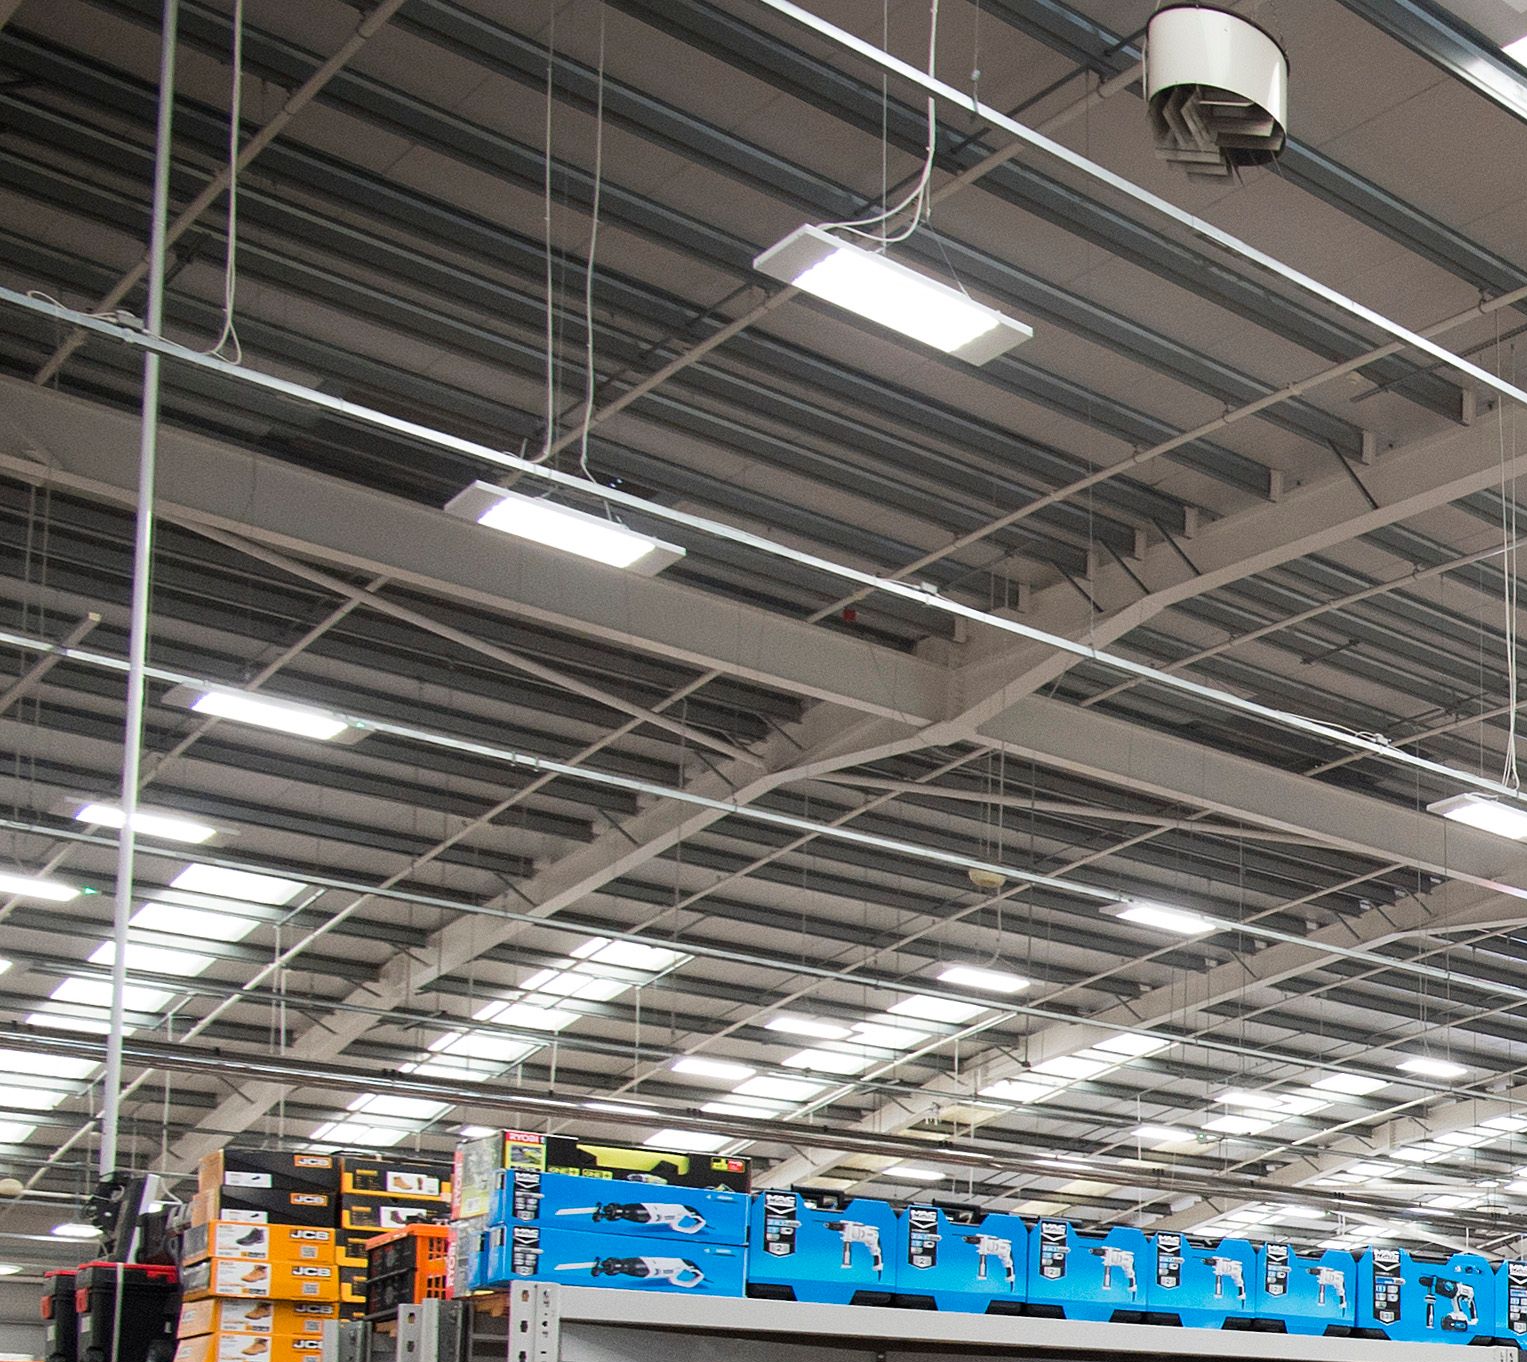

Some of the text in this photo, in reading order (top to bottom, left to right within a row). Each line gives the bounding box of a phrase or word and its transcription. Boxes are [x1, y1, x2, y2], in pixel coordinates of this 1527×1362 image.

[296, 1156, 331, 1168] JCB
[292, 1194, 326, 1205] JCB
[291, 1230, 330, 1241] JCB
[292, 1266, 331, 1278] JCB
[295, 1303, 332, 1315] JCB
